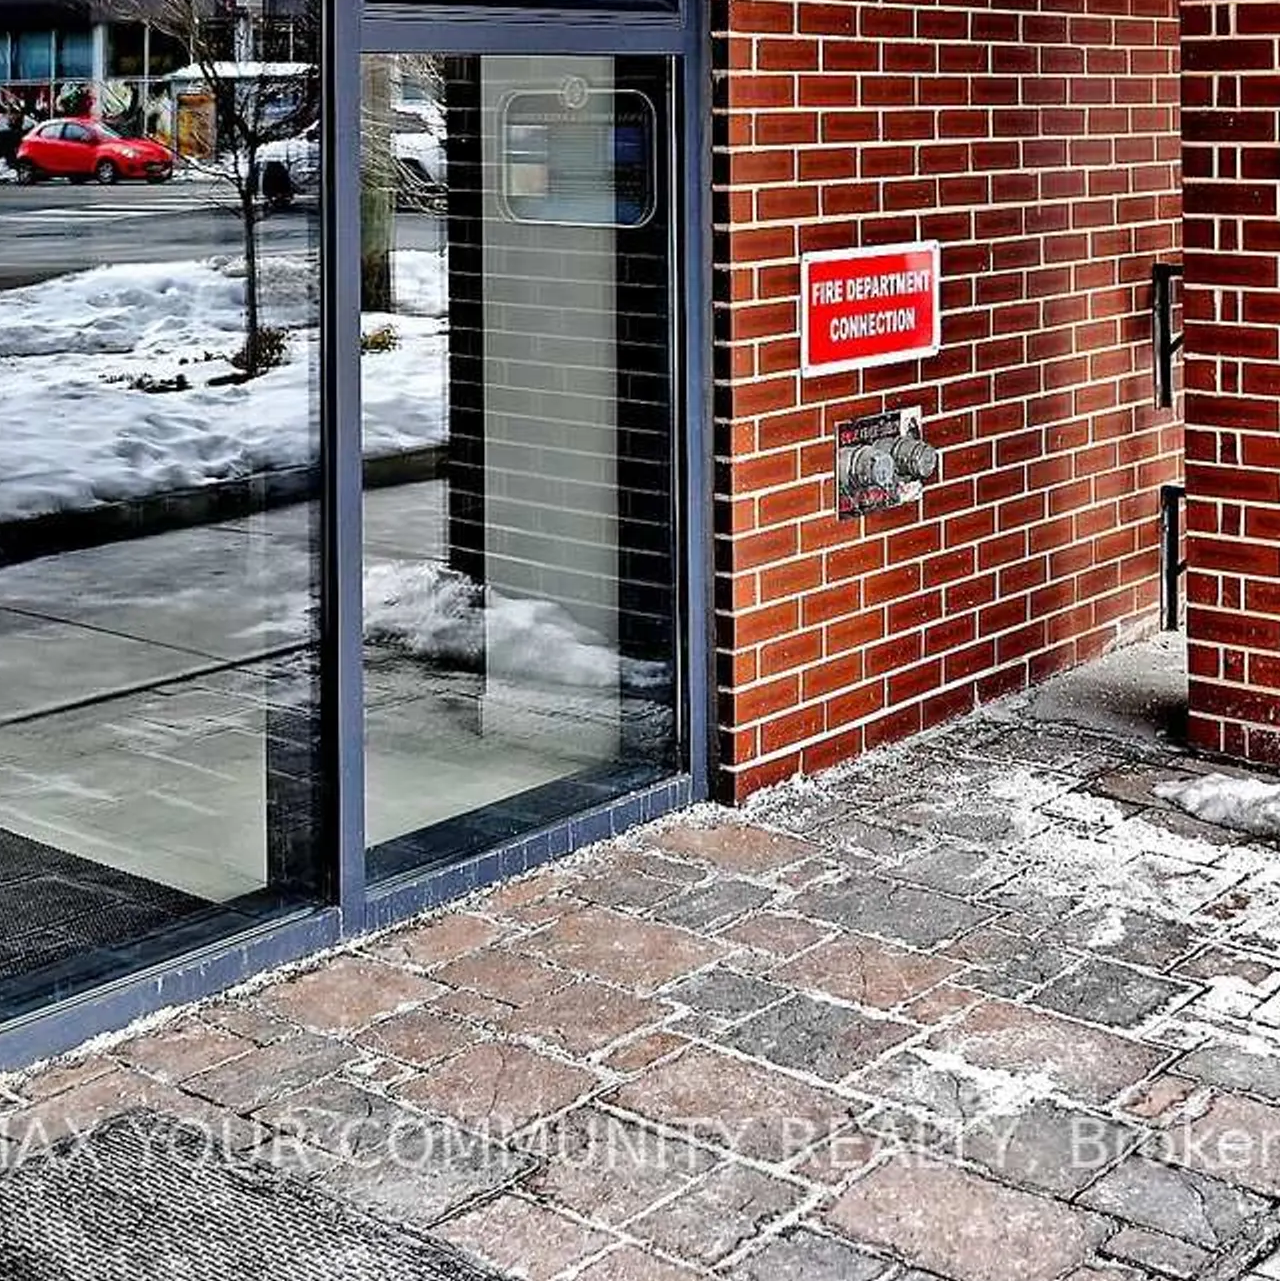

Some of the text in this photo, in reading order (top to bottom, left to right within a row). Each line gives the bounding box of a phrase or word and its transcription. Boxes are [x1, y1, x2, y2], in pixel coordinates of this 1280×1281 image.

[812, 269, 931, 306] FIRE DEPARTMENT
[829, 307, 916, 342] CONNECTION
